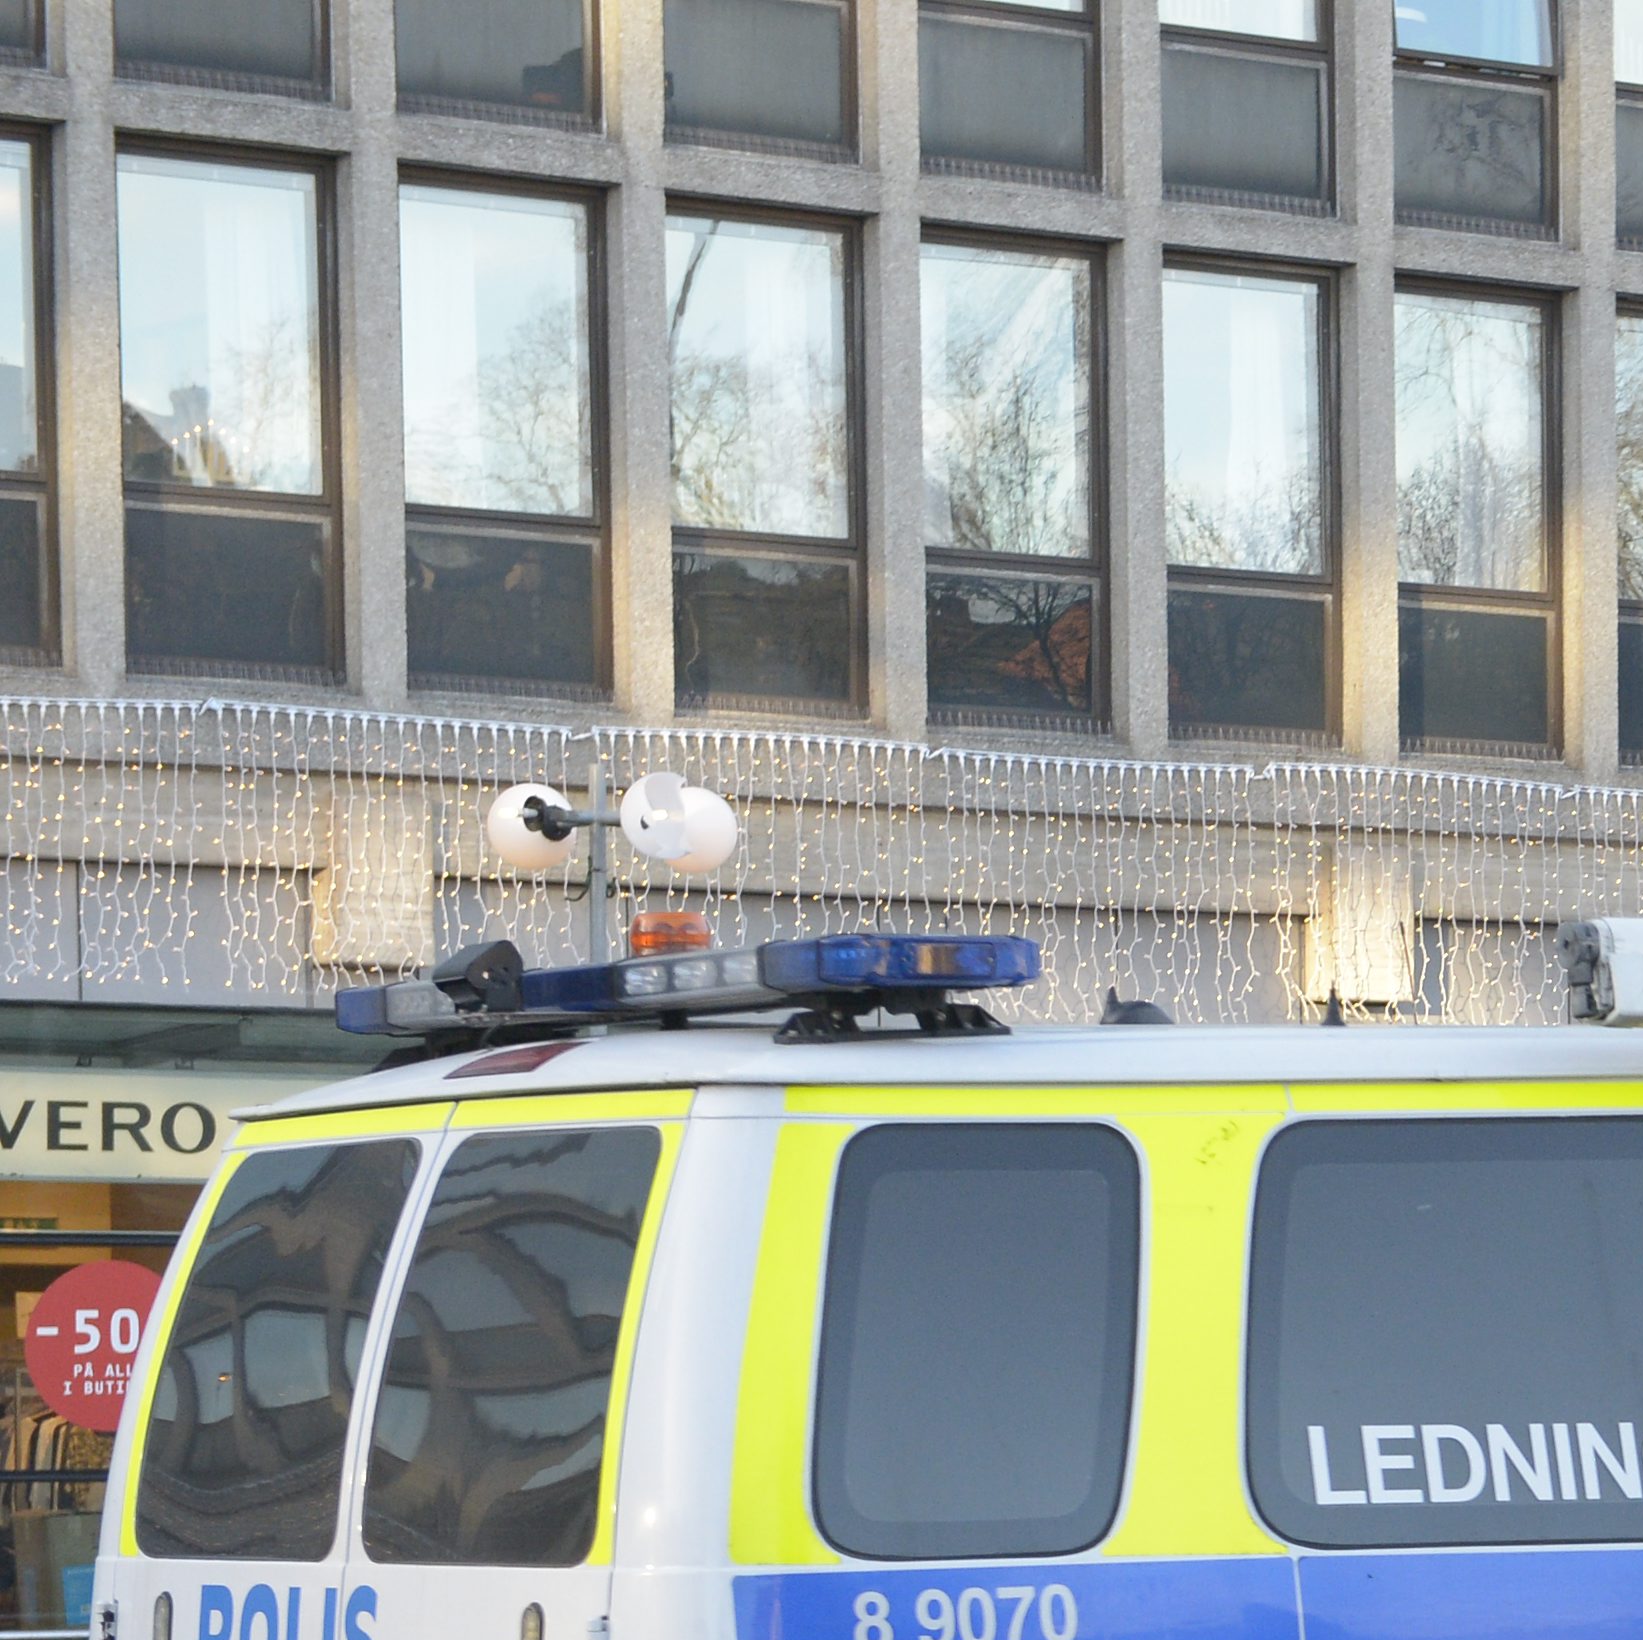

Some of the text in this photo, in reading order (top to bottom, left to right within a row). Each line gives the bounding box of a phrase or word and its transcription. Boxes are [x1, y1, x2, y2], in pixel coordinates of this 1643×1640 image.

[0, 1100, 217, 1154] VERO
[73, 1362, 94, 1378] PÅ
[63, 1380, 130, 1395] I BUTI
